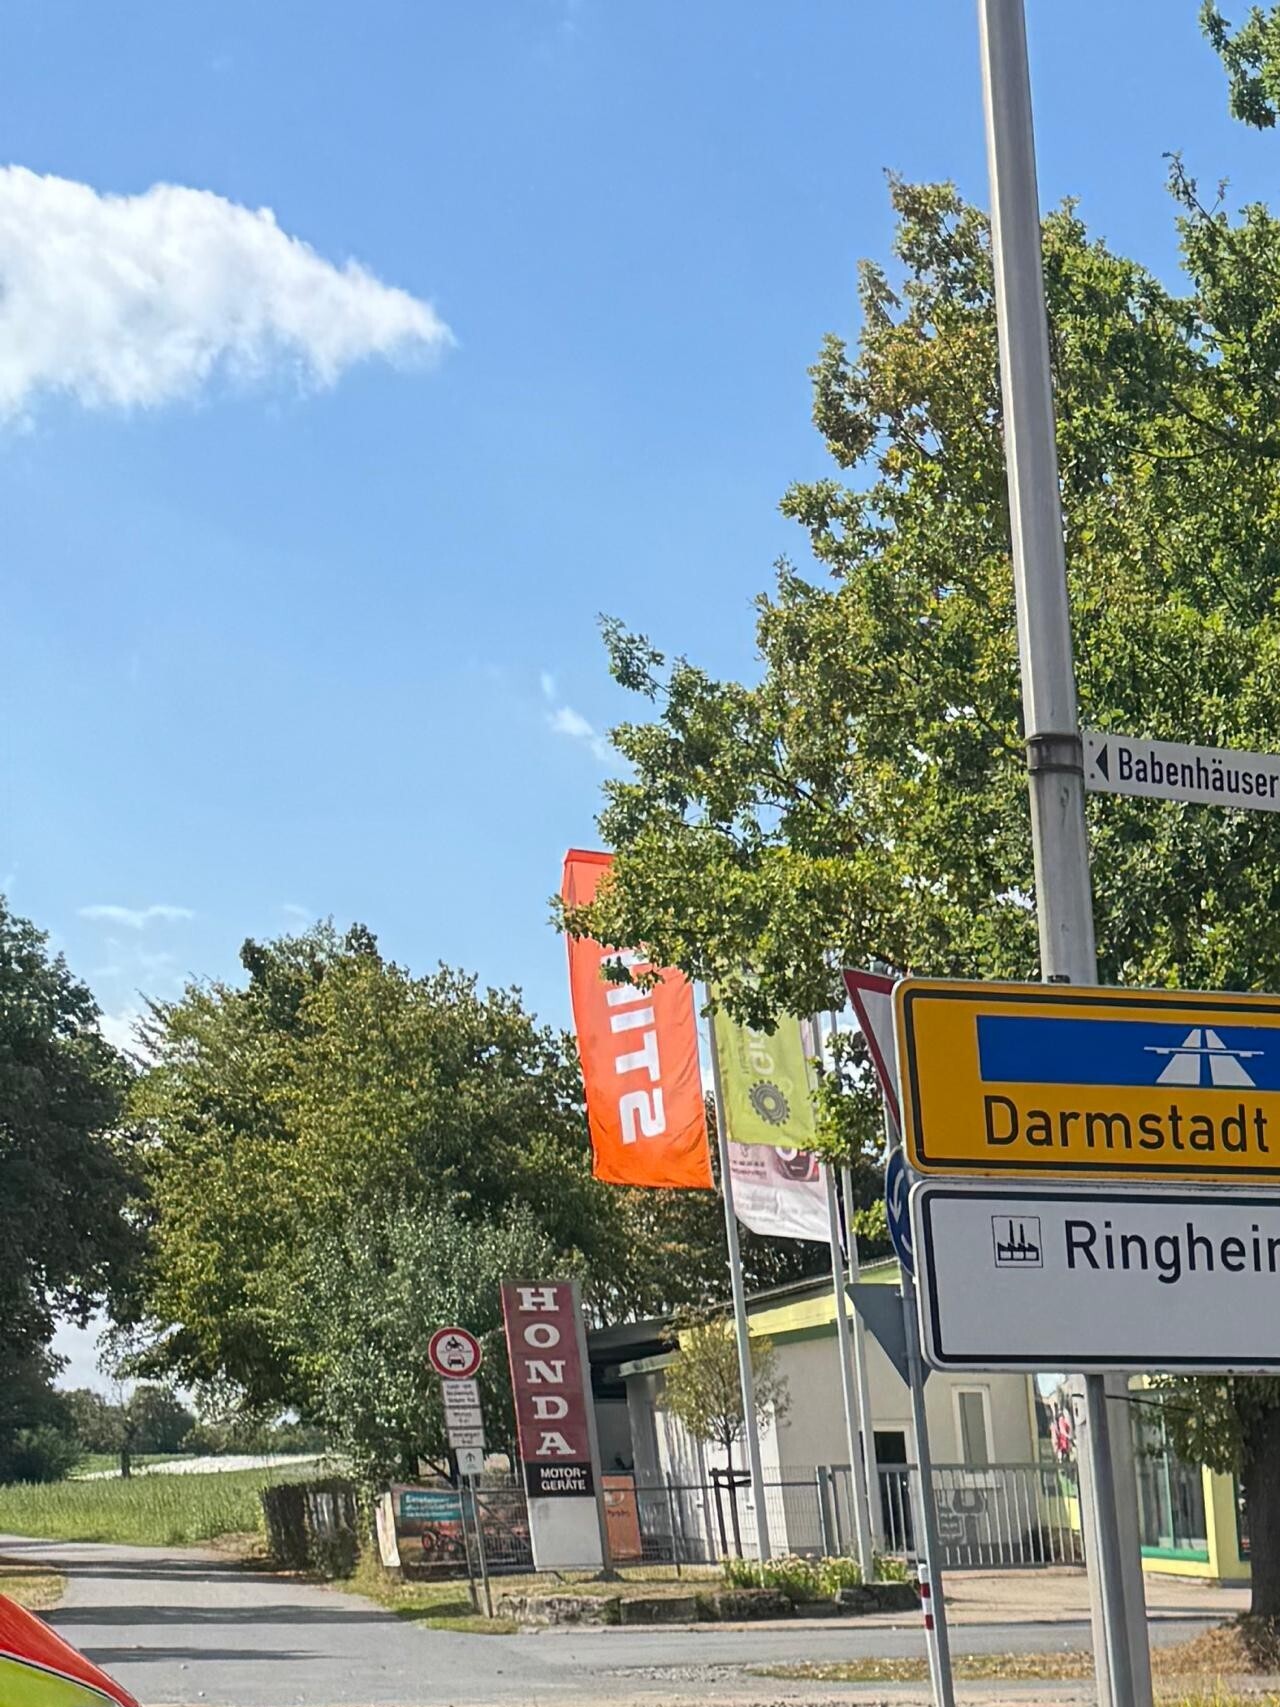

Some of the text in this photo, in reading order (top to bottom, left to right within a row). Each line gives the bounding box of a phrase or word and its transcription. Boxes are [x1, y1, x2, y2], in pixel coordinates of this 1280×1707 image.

[1118, 747, 1279, 799] Babenhäuser
[983, 1094, 1270, 1154] Darmstadt
[515, 1286, 577, 1456] HONDA
[539, 1467, 588, 1480] MOTOR-
[540, 1477, 587, 1491] GERÄTE
